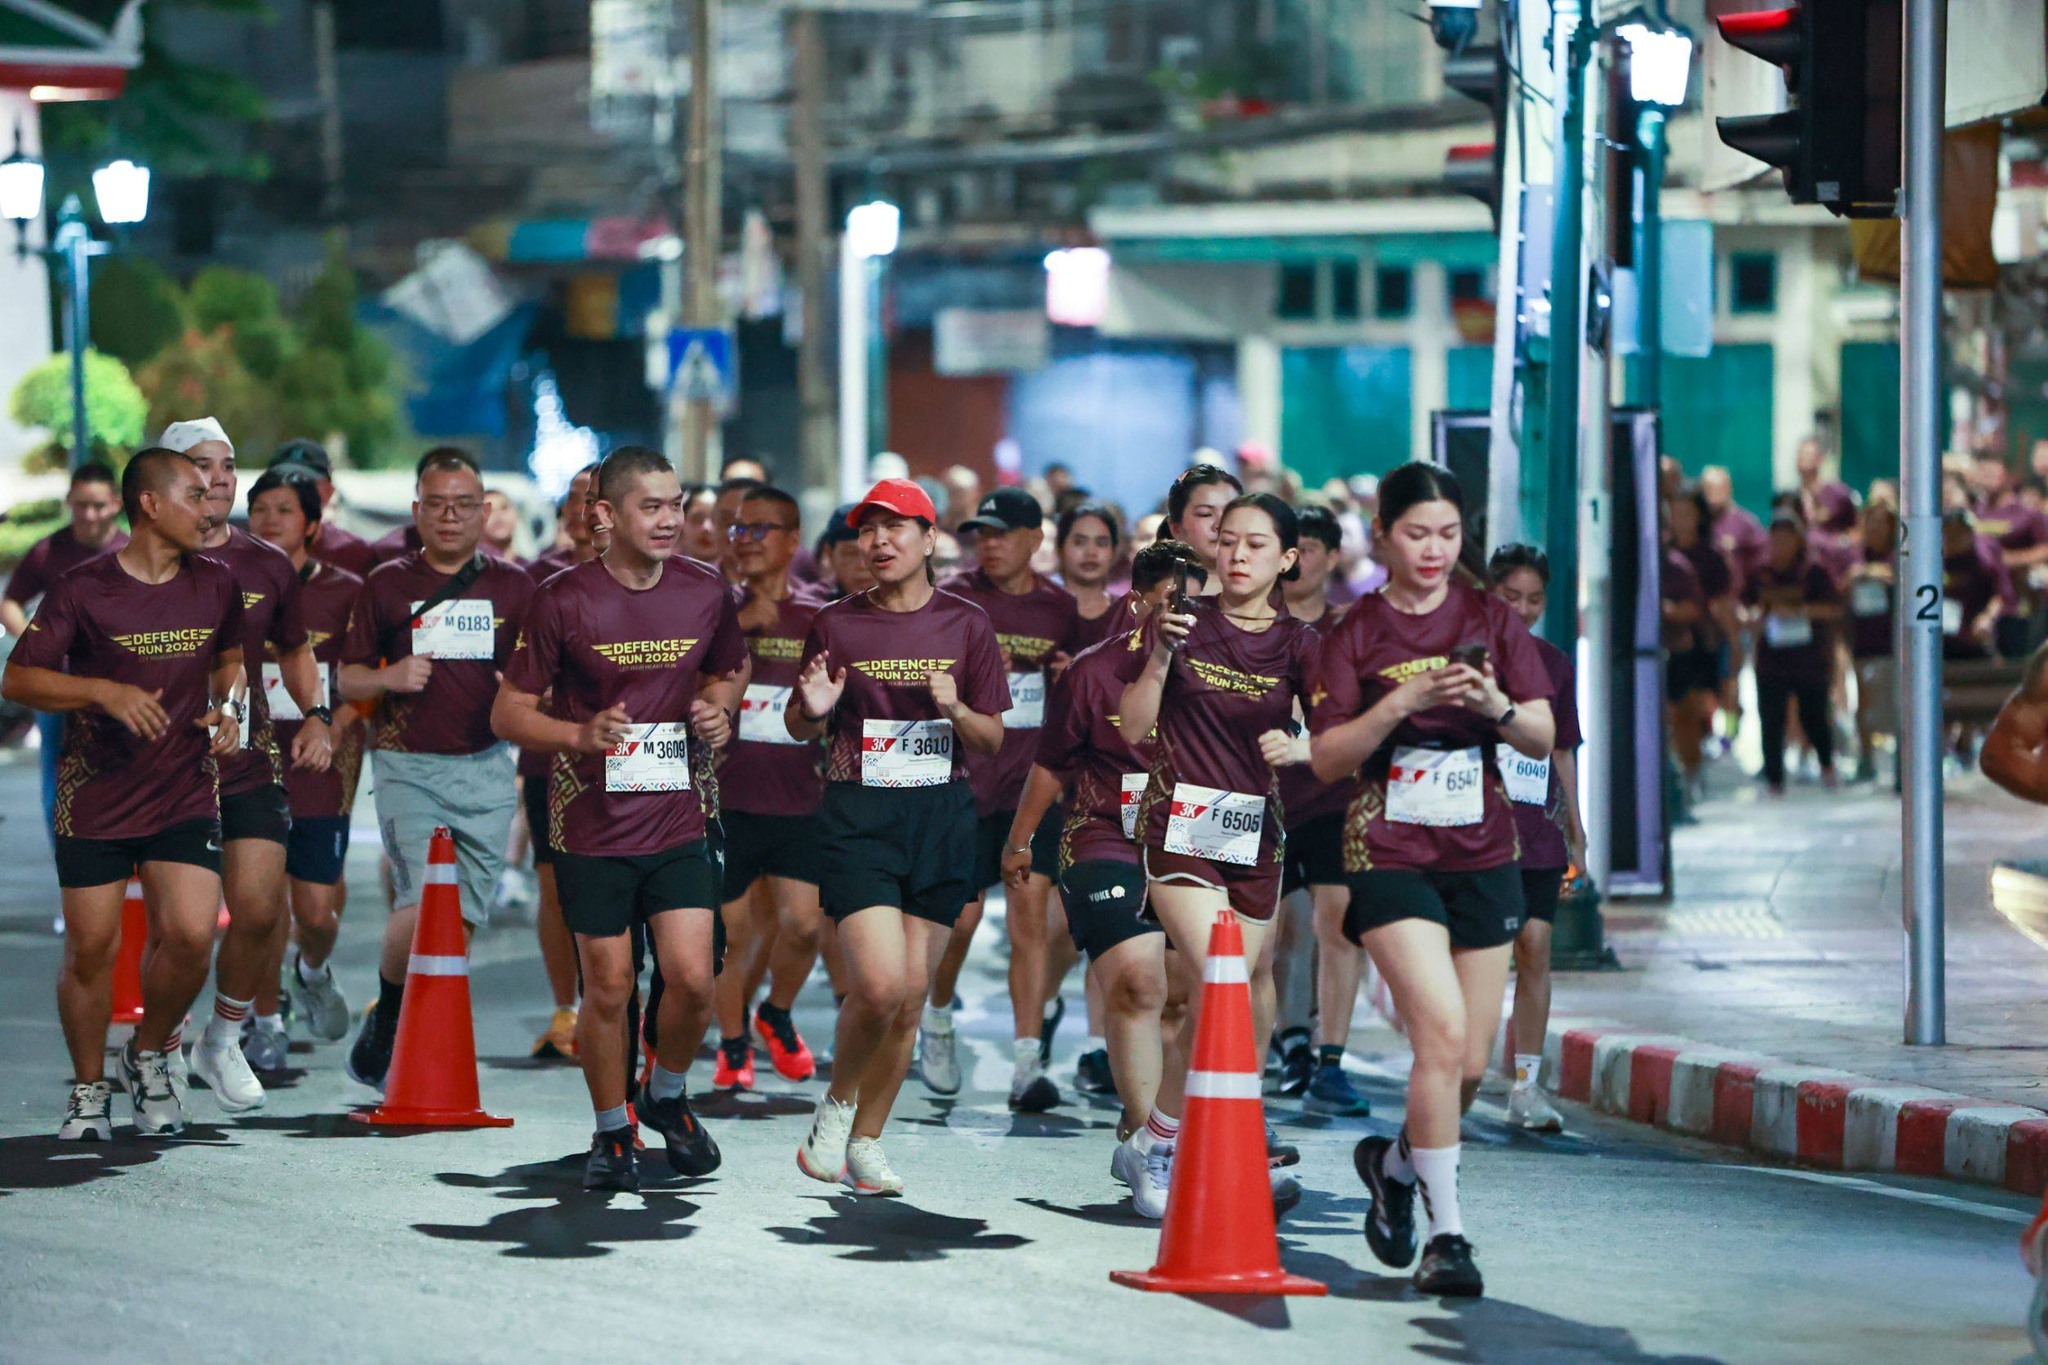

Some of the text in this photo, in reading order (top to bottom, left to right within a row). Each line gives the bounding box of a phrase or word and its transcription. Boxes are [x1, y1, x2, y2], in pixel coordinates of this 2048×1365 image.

[1916, 584, 1939, 620] 2
[445, 615, 490, 631] M 6183
[133, 629, 198, 645] DEFENCE
[138, 641, 196, 655] RUN 2026
[613, 640, 680, 655] DEFENCE
[618, 652, 677, 665] RUN 2026
[871, 659, 937, 671] DEFENCE
[875, 671, 927, 681] RUN 202
[1206, 675, 1231, 689] RUN
[615, 742, 631, 756] 3K
[643, 741, 686, 759] M 3609
[871, 738, 888, 751] 3K
[902, 736, 950, 756] F 3610
[1517, 761, 1547, 779] 6049
[1433, 767, 1480, 791] F 6547
[1180, 803, 1198, 817] 3K
[1212, 808, 1260, 833] F 6505
[1089, 889, 1111, 902] YOKE
